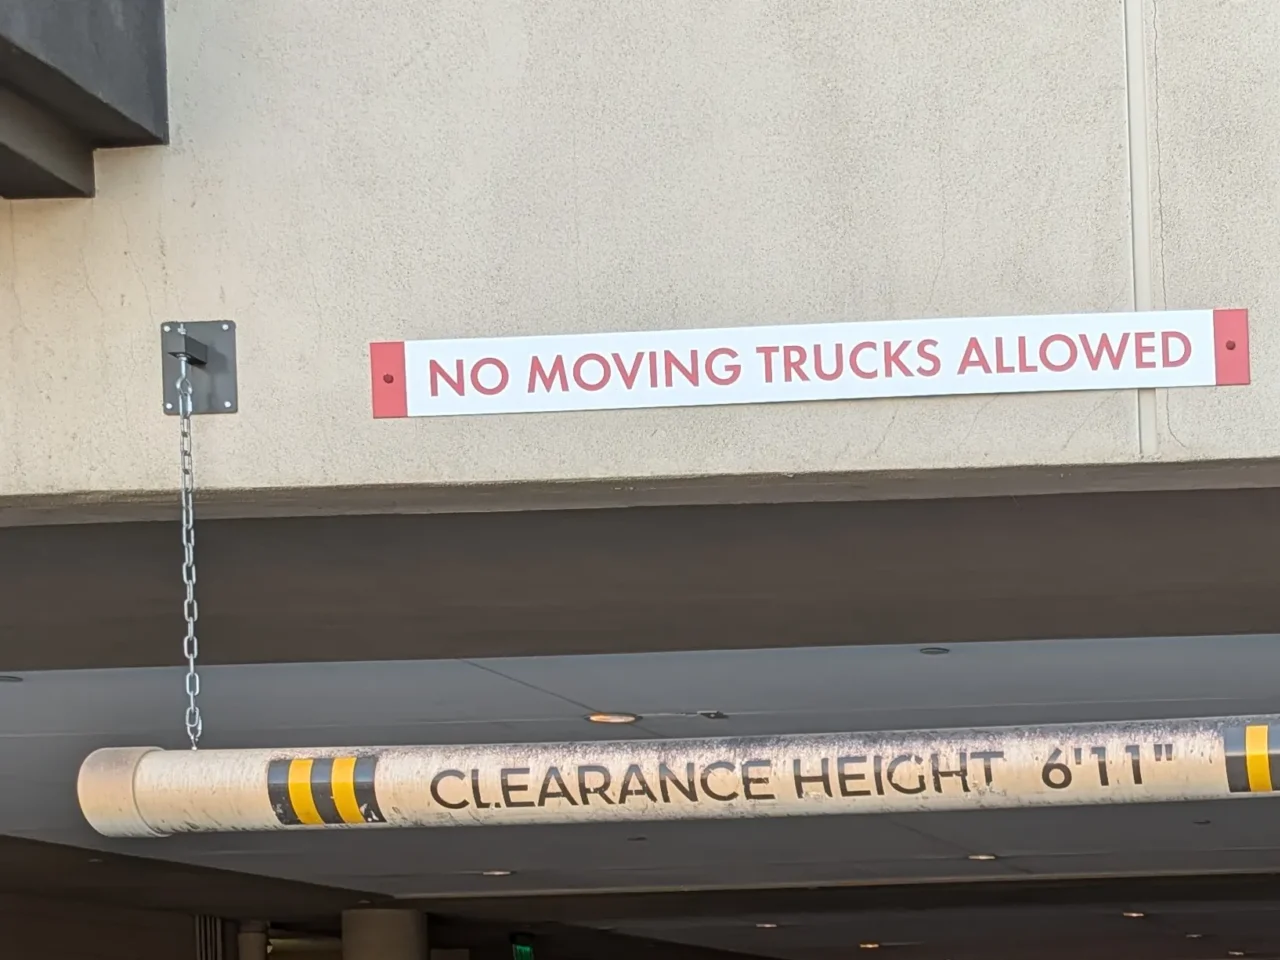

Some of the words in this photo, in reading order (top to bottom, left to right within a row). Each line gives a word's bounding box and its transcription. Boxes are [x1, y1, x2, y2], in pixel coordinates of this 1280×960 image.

[427, 355, 509, 398] NO
[525, 347, 742, 394] MOVING
[755, 337, 941, 384] TRUCKS
[956, 330, 1192, 376] ALLOWED
[429, 757, 775, 811] CLEARANCE
[791, 750, 1005, 802] HEIGHT
[1040, 743, 1174, 789] 6'11"
